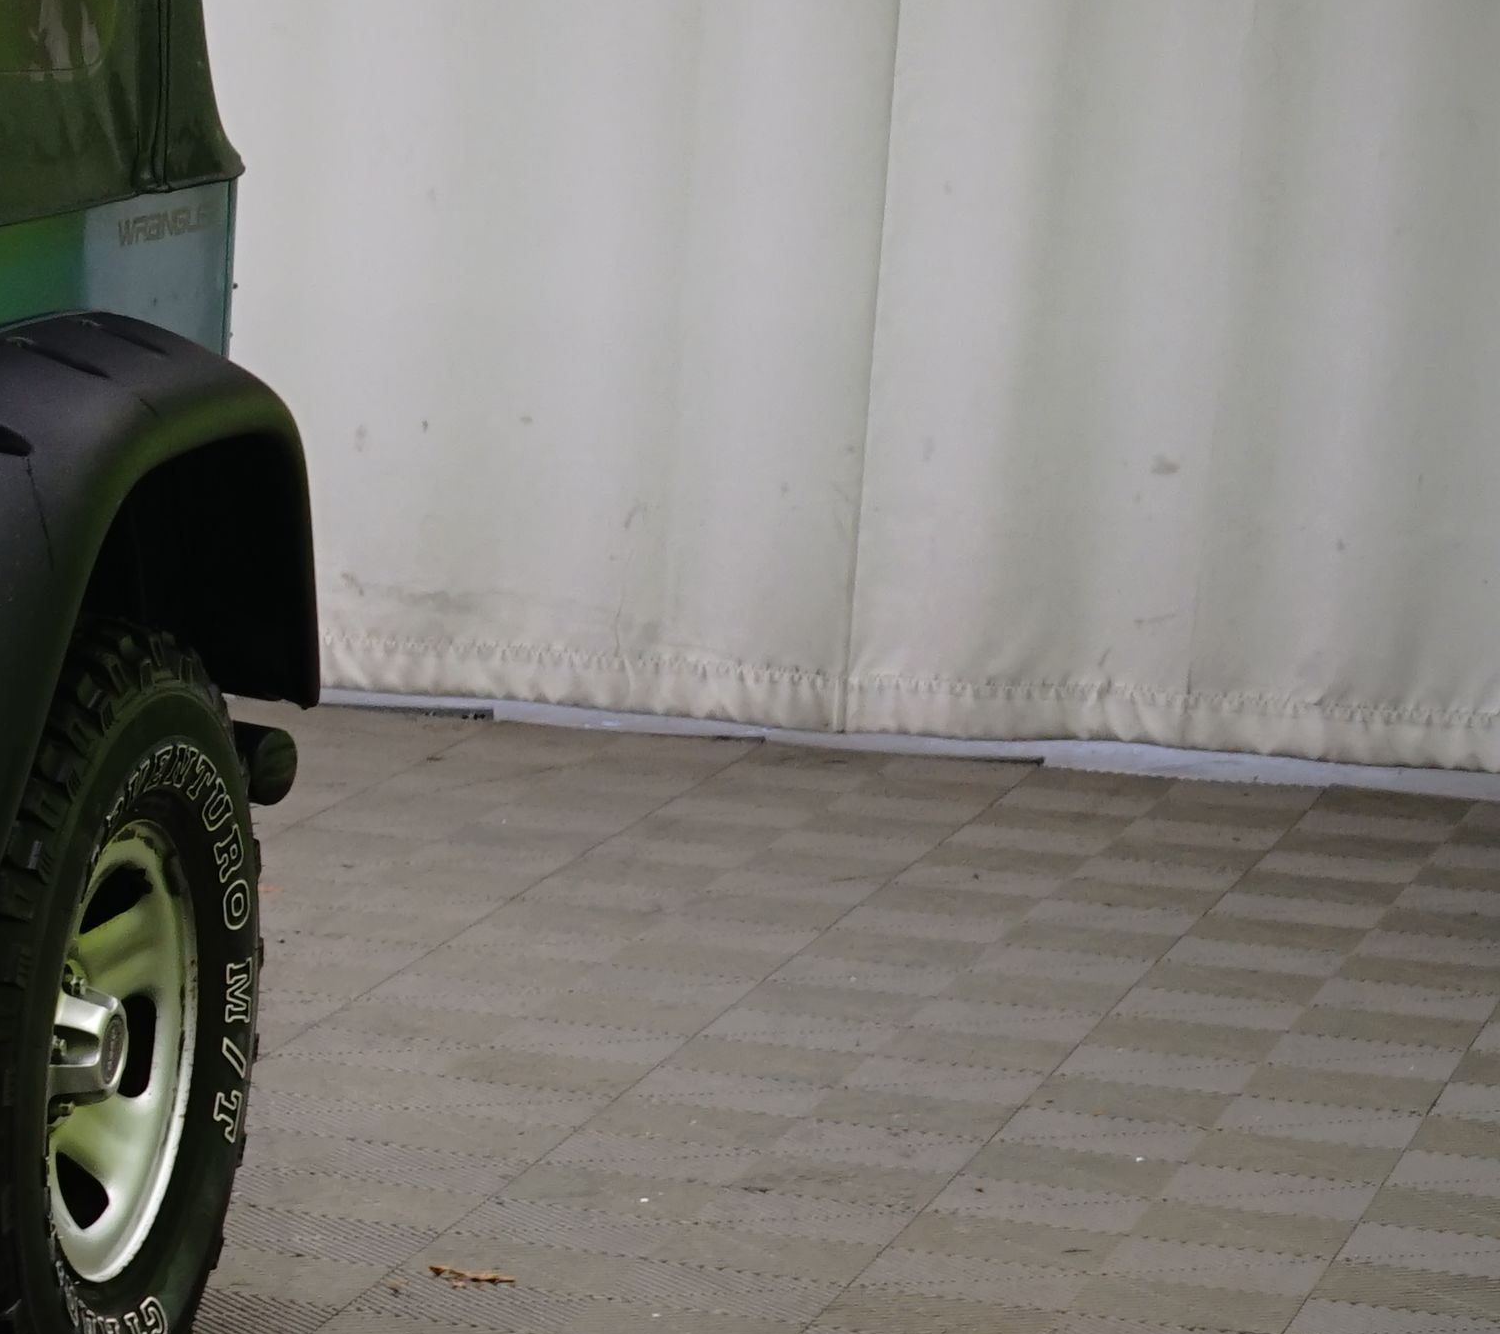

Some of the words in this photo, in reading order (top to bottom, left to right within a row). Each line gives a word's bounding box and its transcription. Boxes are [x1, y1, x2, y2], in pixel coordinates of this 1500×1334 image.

[117, 205, 216, 247] WRANGL
[104, 743, 251, 932] VENTURO
[213, 956, 253, 1144] M/T
